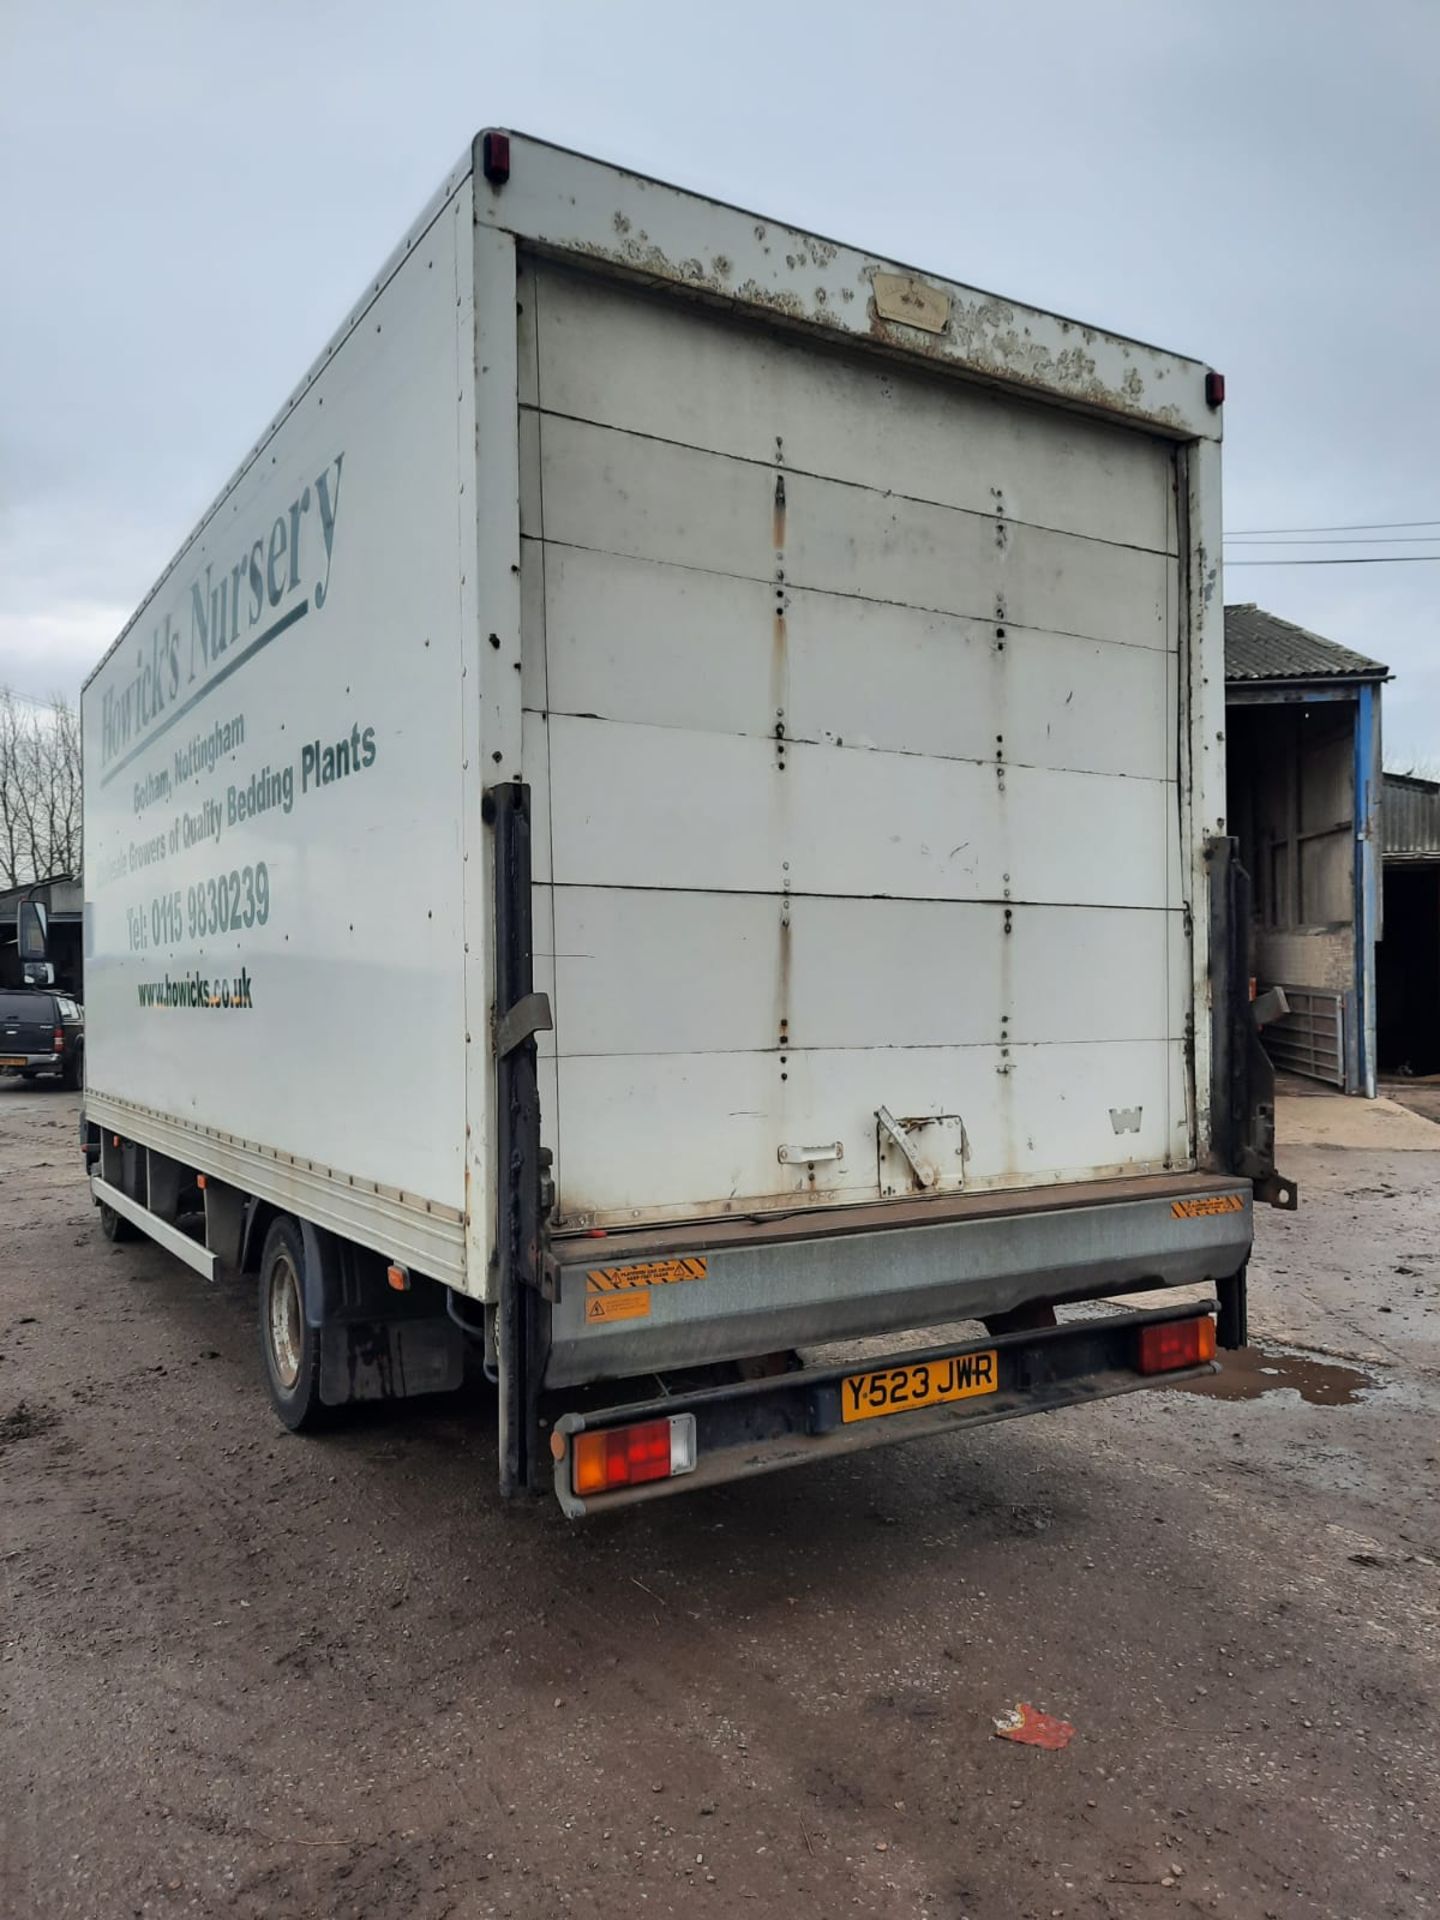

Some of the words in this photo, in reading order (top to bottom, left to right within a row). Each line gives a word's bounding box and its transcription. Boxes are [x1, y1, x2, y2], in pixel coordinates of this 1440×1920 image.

[101, 613, 180, 768] Howick's
[188, 451, 345, 682] Nursery
[174, 713, 245, 786] Nottingham
[129, 833, 166, 873] Growers
[168, 817, 181, 856] of
[182, 799, 223, 850] Quality
[227, 765, 294, 828] Bedding
[301, 722, 377, 794] Plants
[127, 905, 148, 951] Tel:
[151, 890, 183, 947] 0115
[187, 861, 271, 940] 9830239
[137, 966, 253, 1009] www.howicks.co.uk
[848, 1366, 930, 1410] Y523
[937, 1354, 993, 1394] JWR
